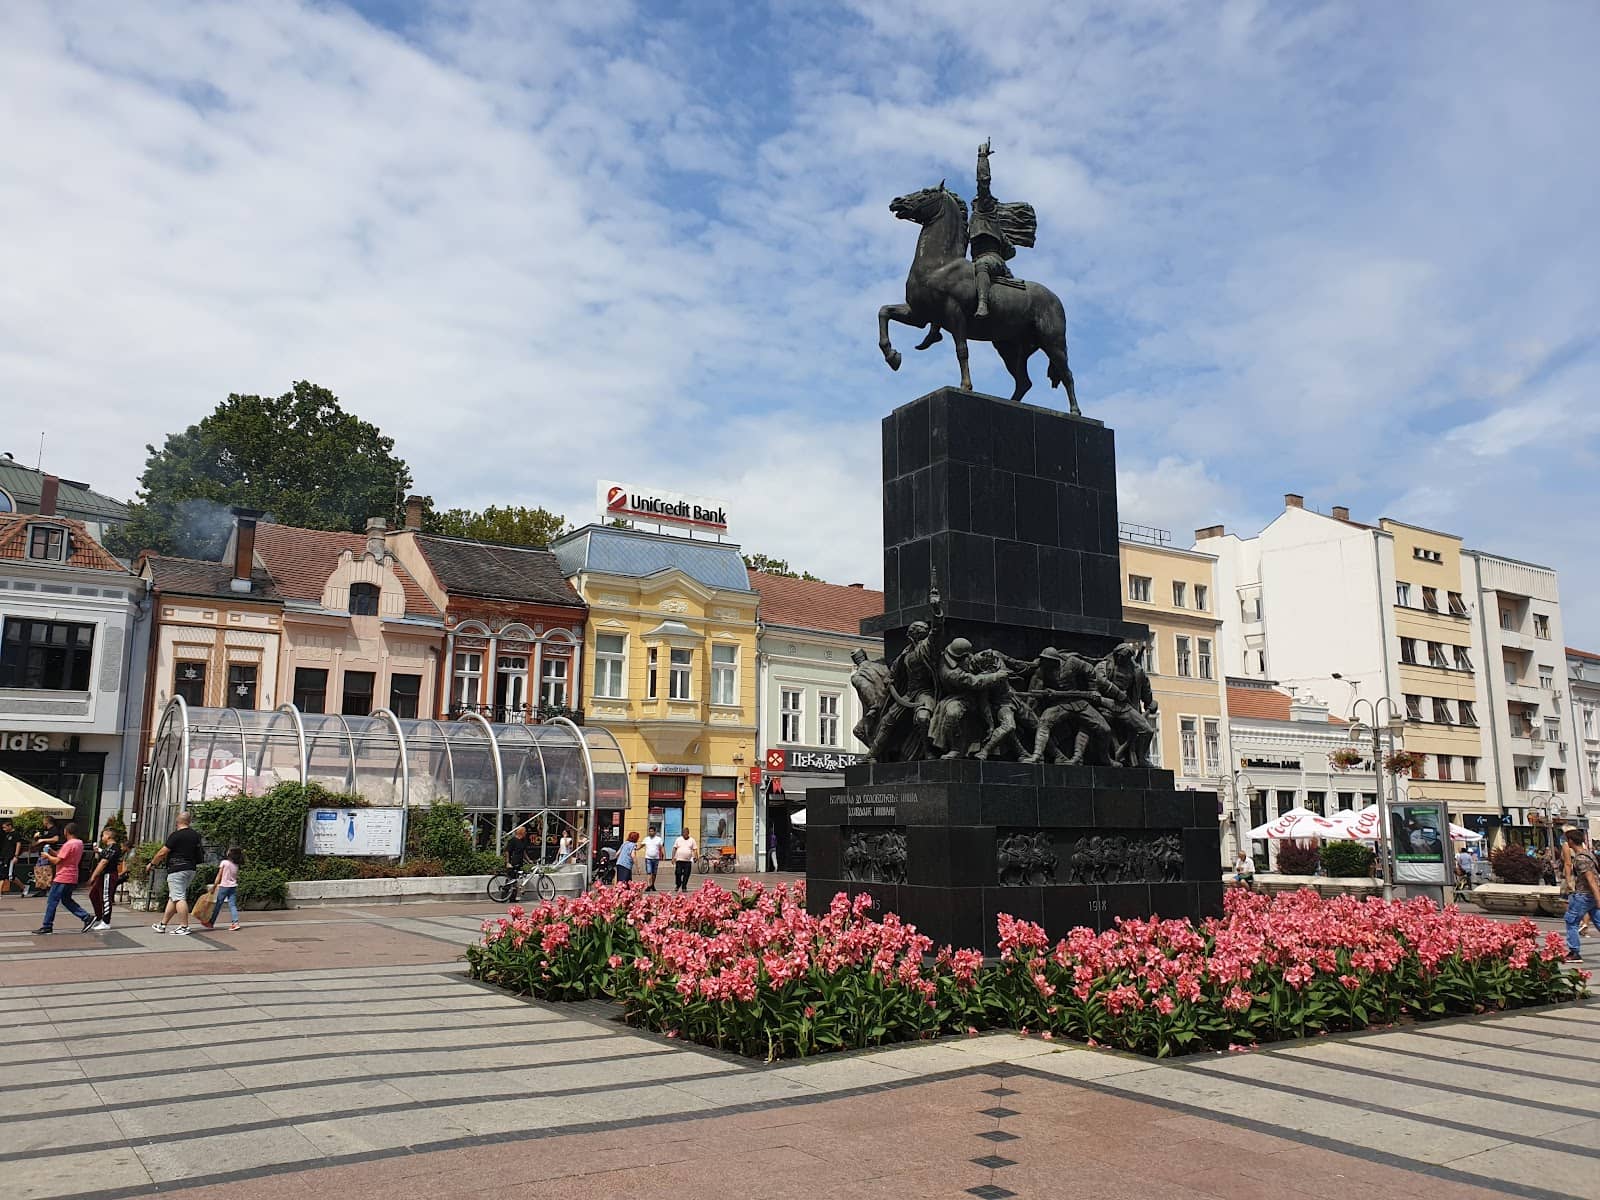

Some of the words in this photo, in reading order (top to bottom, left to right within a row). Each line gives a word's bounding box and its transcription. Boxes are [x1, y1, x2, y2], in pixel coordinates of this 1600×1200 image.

[631, 494, 691, 517] UniCredit
[693, 505, 727, 524] Bank
[0, 732, 49, 751] ld's
[1266, 815, 1297, 838] Coca
[1346, 812, 1377, 838] Coca
